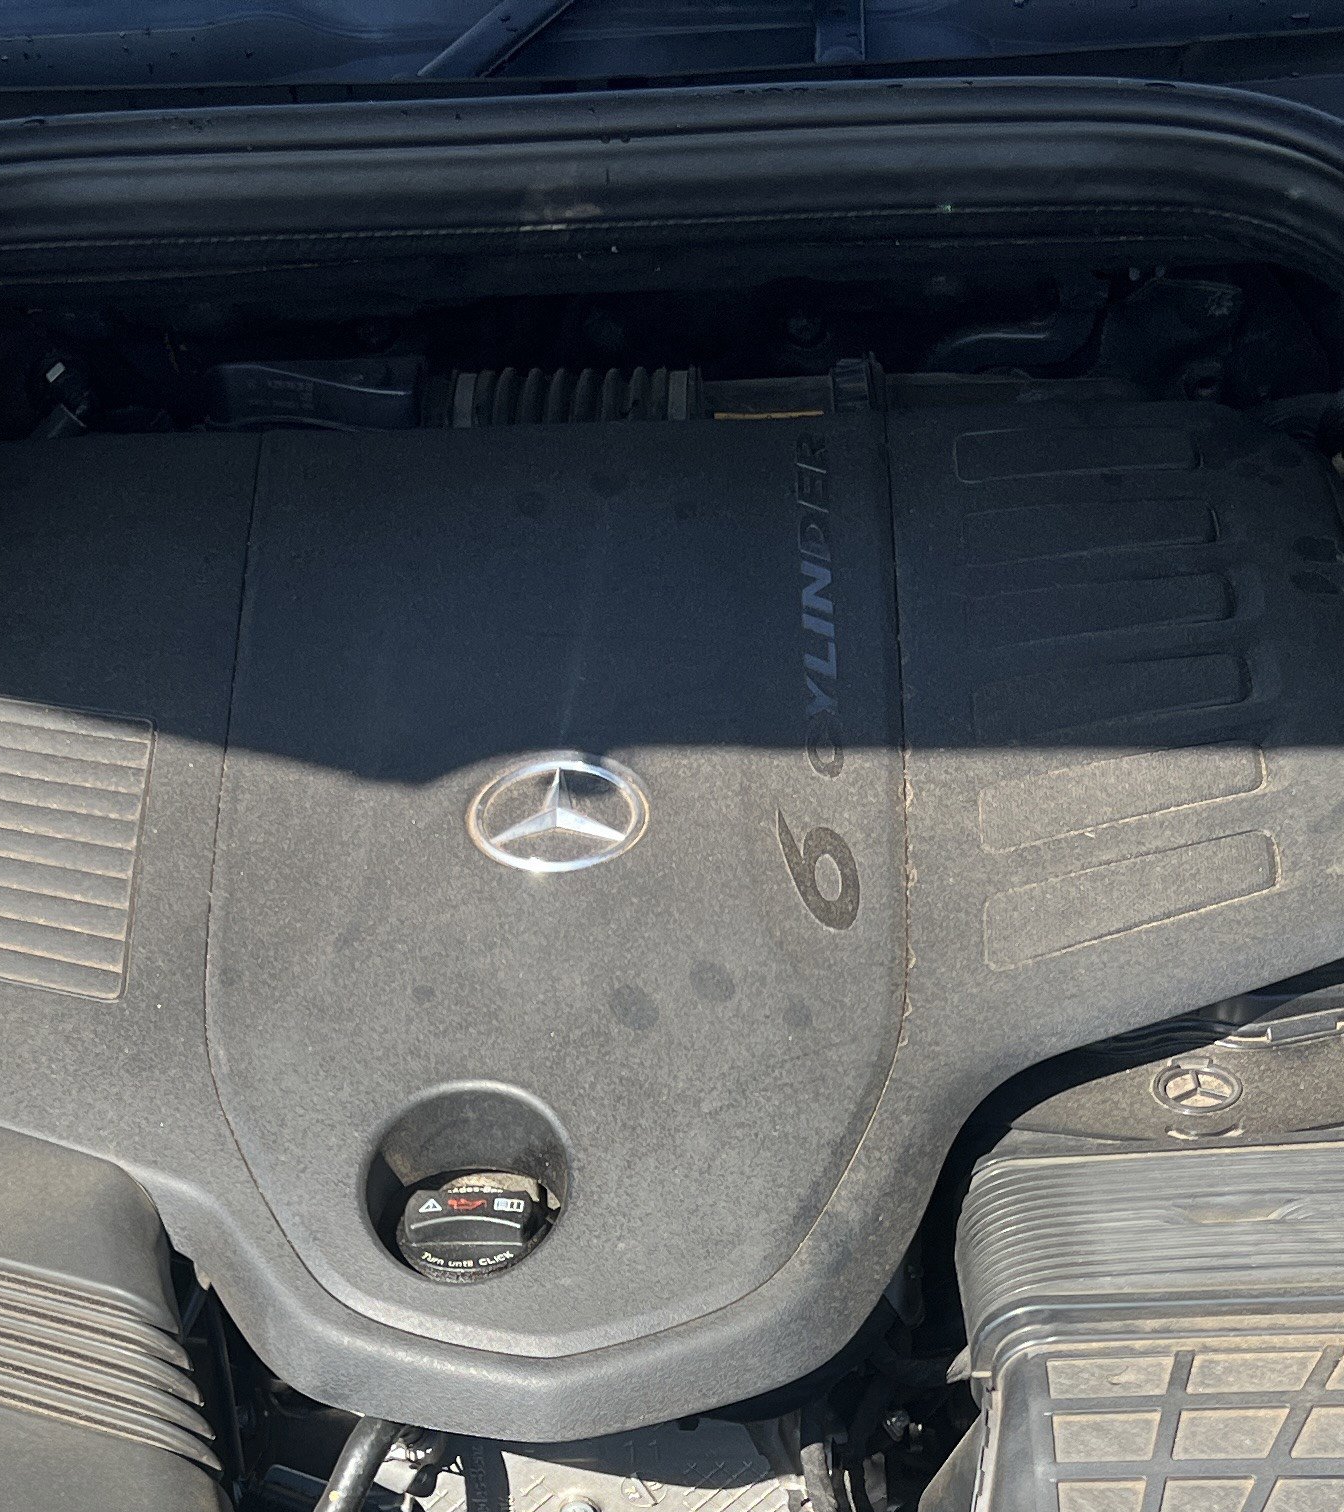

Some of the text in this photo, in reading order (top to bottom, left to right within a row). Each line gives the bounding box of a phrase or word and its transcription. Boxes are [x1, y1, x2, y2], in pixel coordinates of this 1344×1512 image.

[775, 429, 861, 932] 6 CYLINDER
[422, 1251, 514, 1268] Turn until CLICK
